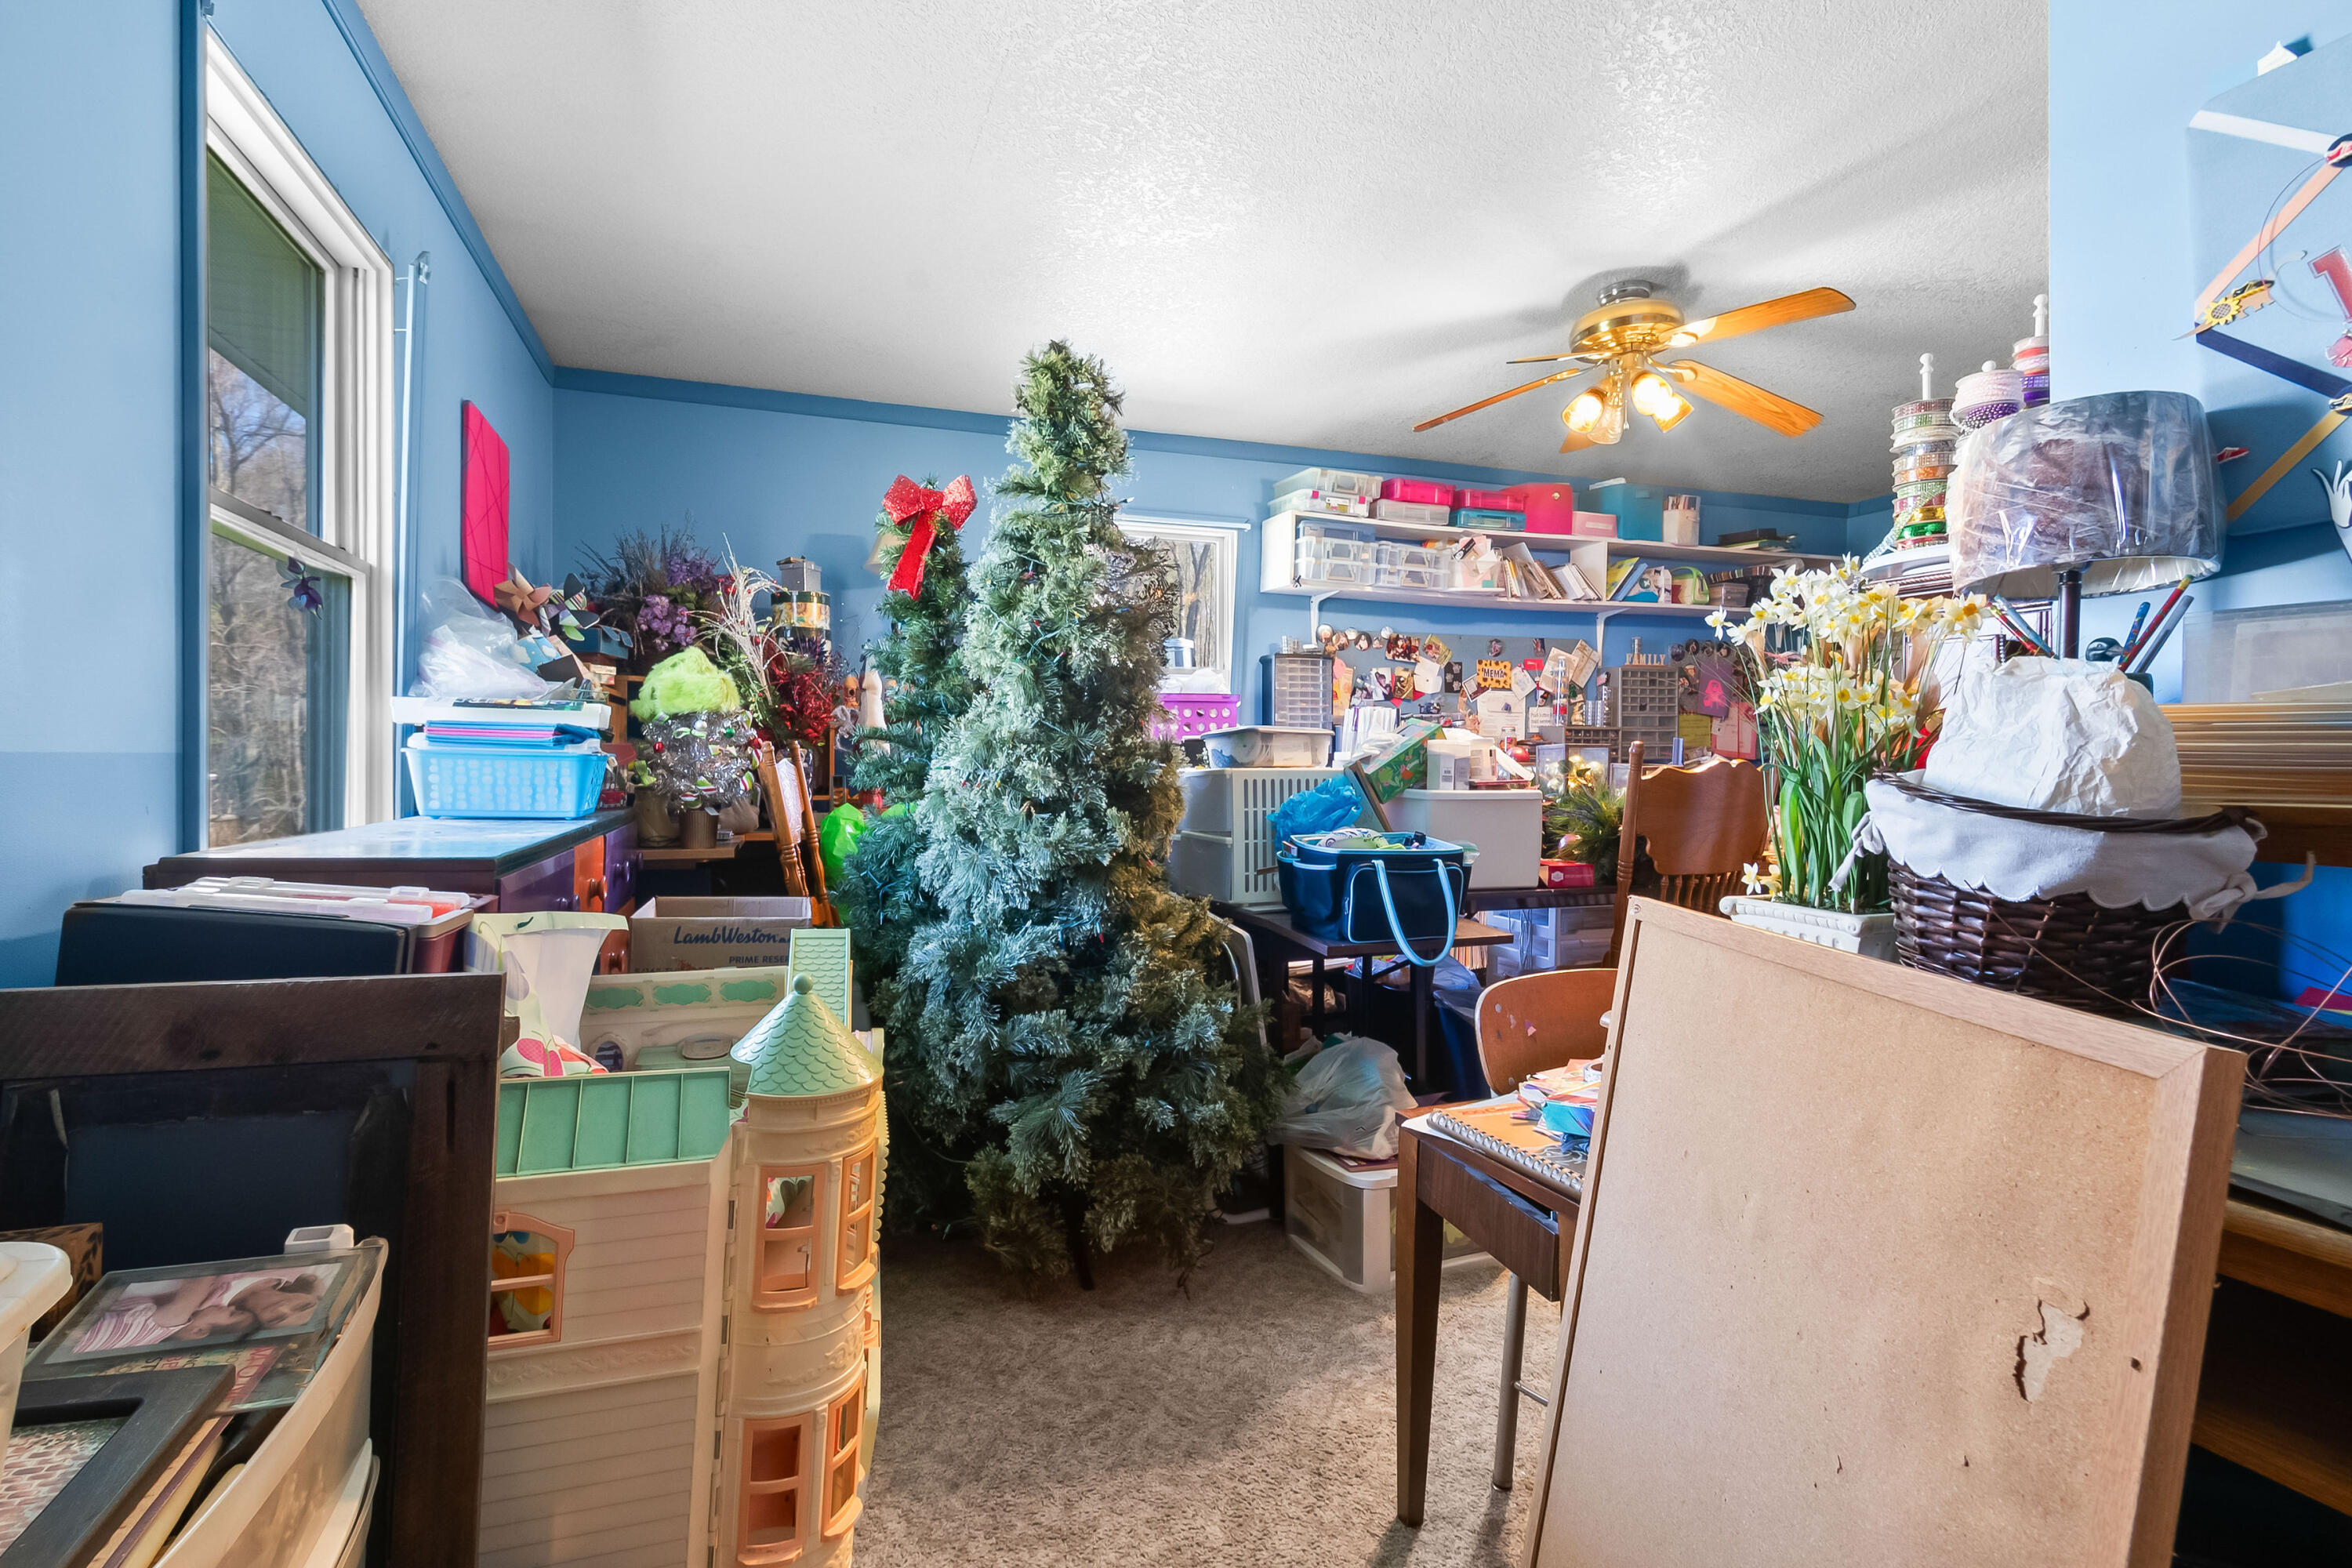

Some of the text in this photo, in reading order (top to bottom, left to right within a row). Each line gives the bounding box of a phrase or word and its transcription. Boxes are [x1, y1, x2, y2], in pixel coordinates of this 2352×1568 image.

[1624, 653, 1666, 666] FAMILY
[1483, 668, 1504, 678] MEMA
[729, 955, 759, 964] PRIME
